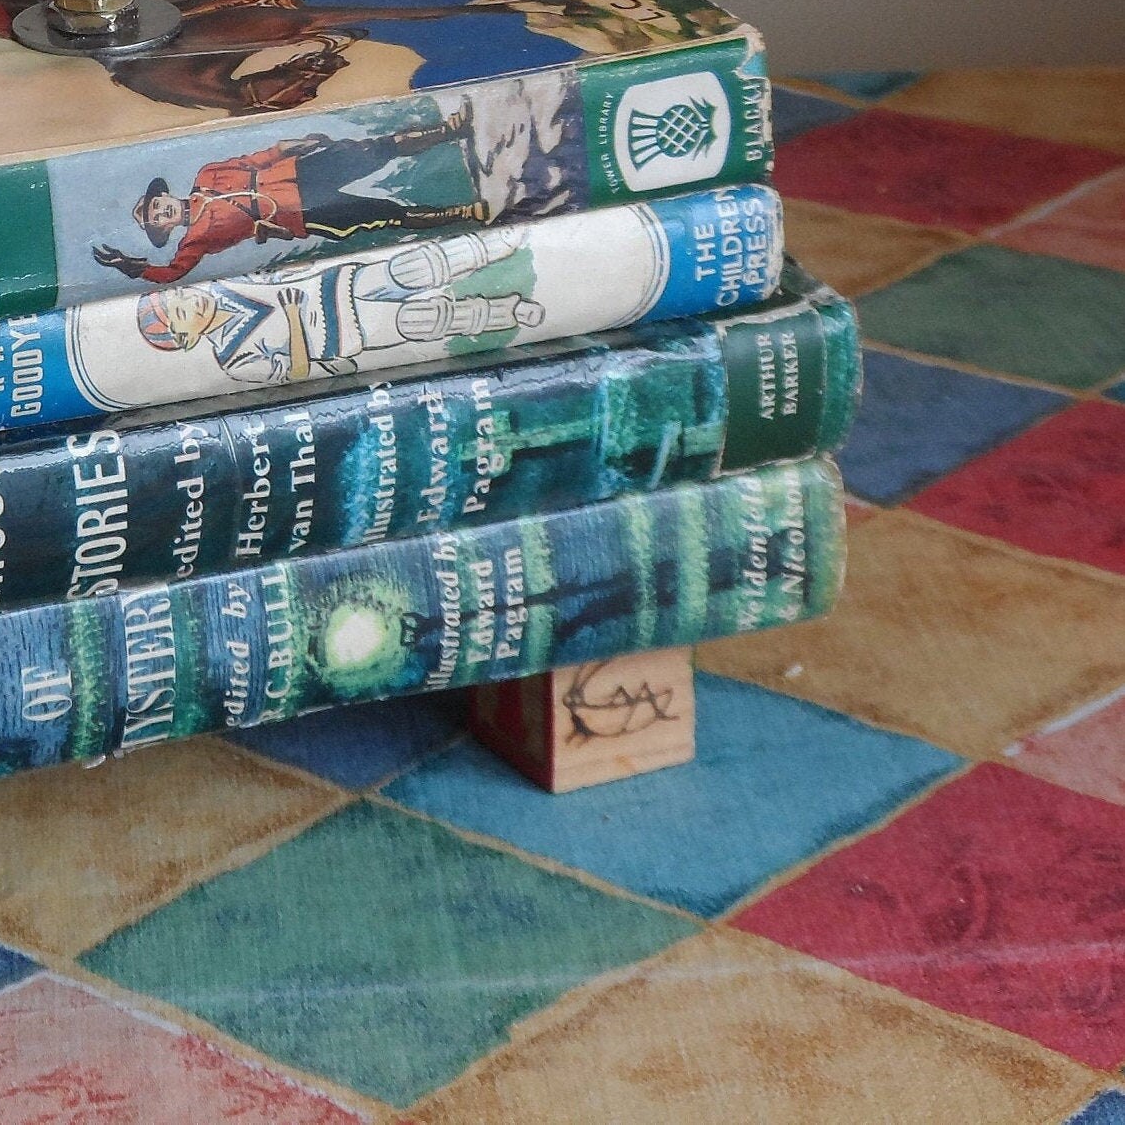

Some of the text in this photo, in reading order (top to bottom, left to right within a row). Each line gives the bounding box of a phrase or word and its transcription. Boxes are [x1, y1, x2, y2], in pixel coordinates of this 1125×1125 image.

[598, 91, 613, 145] LIBRARY
[693, 223, 717, 281] THE
[743, 197, 766, 286] PRESS
[8, 313, 43, 417] GOODYE
[758, 332, 775, 420] ARTHUR
[781, 331, 797, 416] BARKER
[173, 421, 209, 577] edited by
[235, 414, 270, 558] Herbert
[361, 413, 398, 543] llustrated
[417, 388, 448, 523] Edward
[462, 378, 506, 514] Pagram
[66, 429, 128, 601] STORIES
[288, 500, 314, 553] van
[780, 472, 806, 593] Nicolson
[221, 581, 251, 728] edited by
[466, 559, 494, 664] Edward
[496, 545, 529, 660] Pagram
[22, 664, 73, 722] OF
